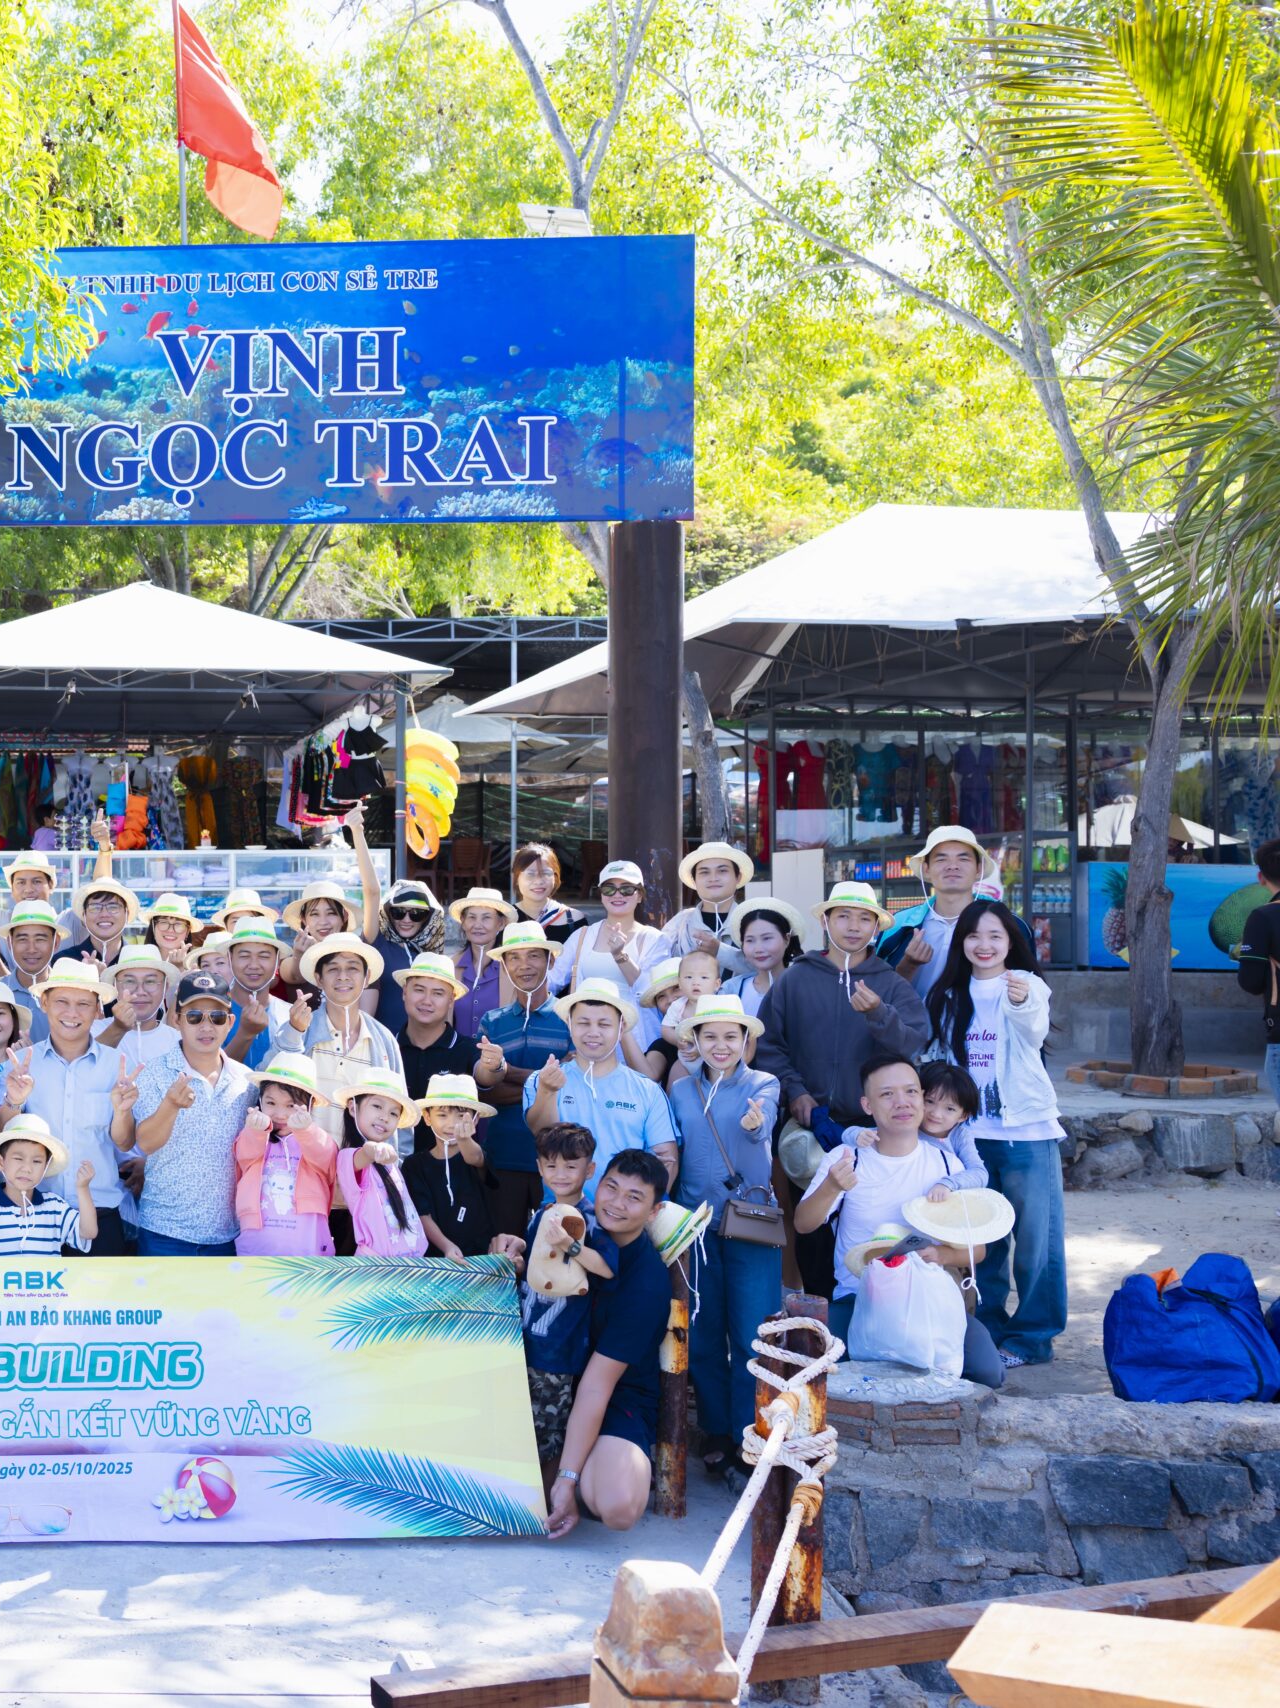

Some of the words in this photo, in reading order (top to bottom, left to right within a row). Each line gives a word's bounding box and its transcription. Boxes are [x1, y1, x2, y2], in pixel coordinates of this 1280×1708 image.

[81, 272, 159, 295] TNHH
[163, 272, 203, 294] DU
[207, 270, 275, 299] LỊCH
[280, 270, 339, 293] CON
[344, 263, 378, 291] SẺ
[383, 268, 439, 290] TRE
[154, 326, 406, 416] VỊNH
[5, 417, 288, 509] NGỌC
[314, 415, 558, 488] TRAI
[616, 1101, 637, 1109] ABK
[3, 1271, 65, 1290] ABK
[6, 1311, 26, 1327] AN
[30, 1306, 58, 1326] BẢO
[64, 1310, 112, 1326] KHANG
[116, 1309, 163, 1325] GROUP
[69, 1399, 126, 1438] KẾT
[130, 1400, 220, 1437] VỮNG
[224, 1399, 312, 1436] VÀNG
[28, 1461, 133, 1476] 02-05/10/2025
